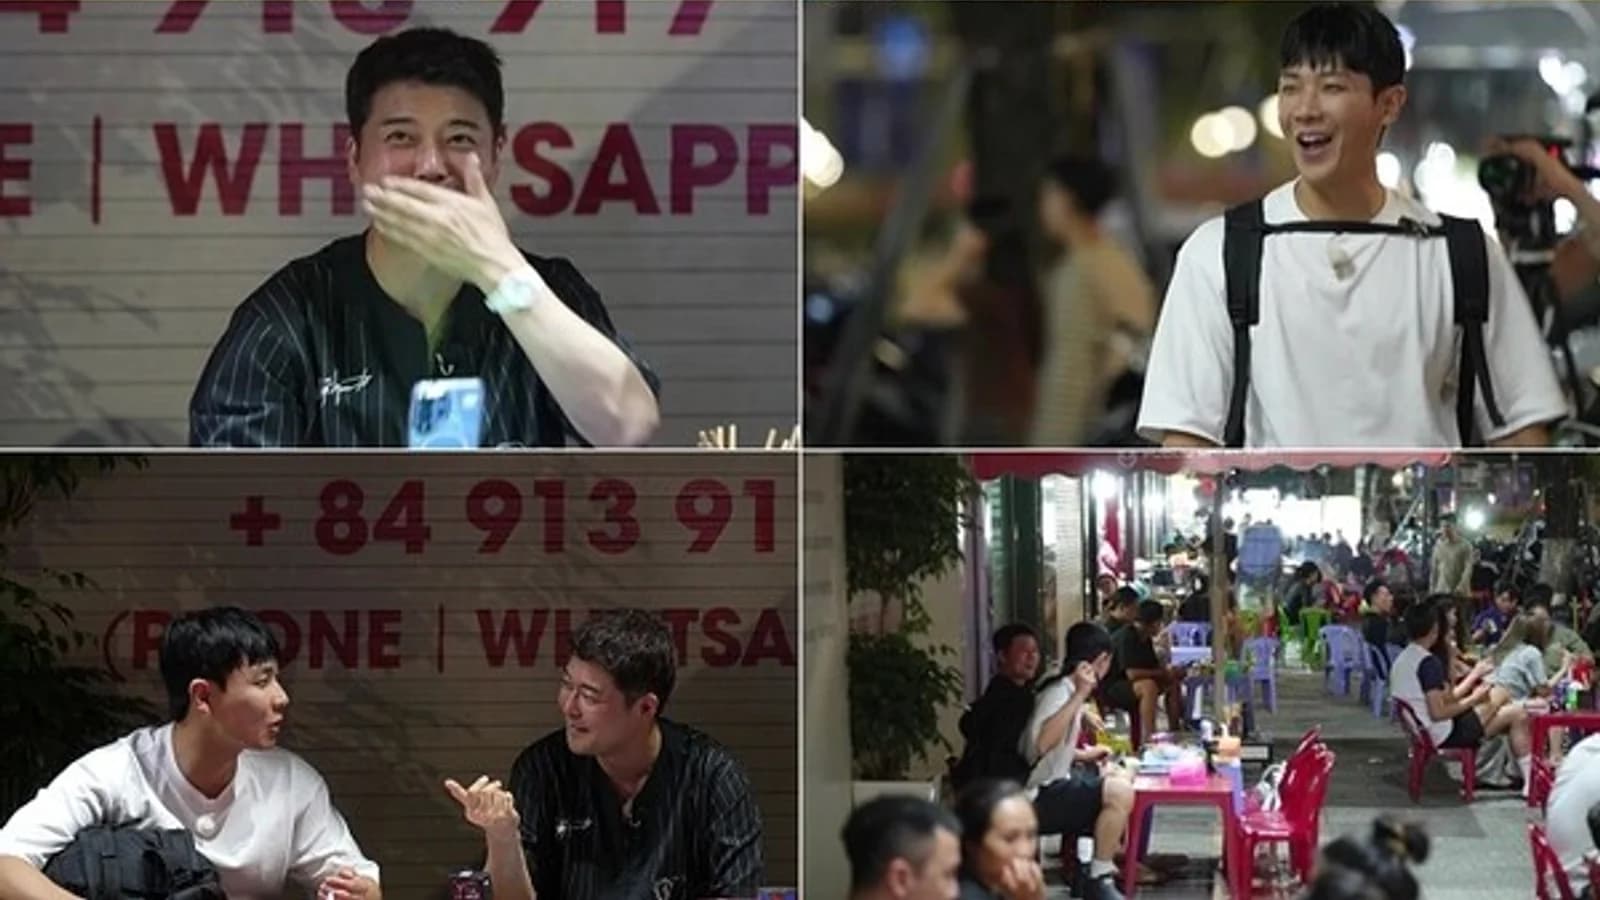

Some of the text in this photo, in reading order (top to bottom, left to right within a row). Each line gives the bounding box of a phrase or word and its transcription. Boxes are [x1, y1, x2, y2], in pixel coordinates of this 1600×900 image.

[153, 122, 797, 217] WHSAPP
[315, 480, 431, 555] 84
[466, 479, 641, 555] 913
[675, 479, 775, 553] 91
[104, 610, 402, 682] (PNE
[476, 608, 797, 668] WTSA
